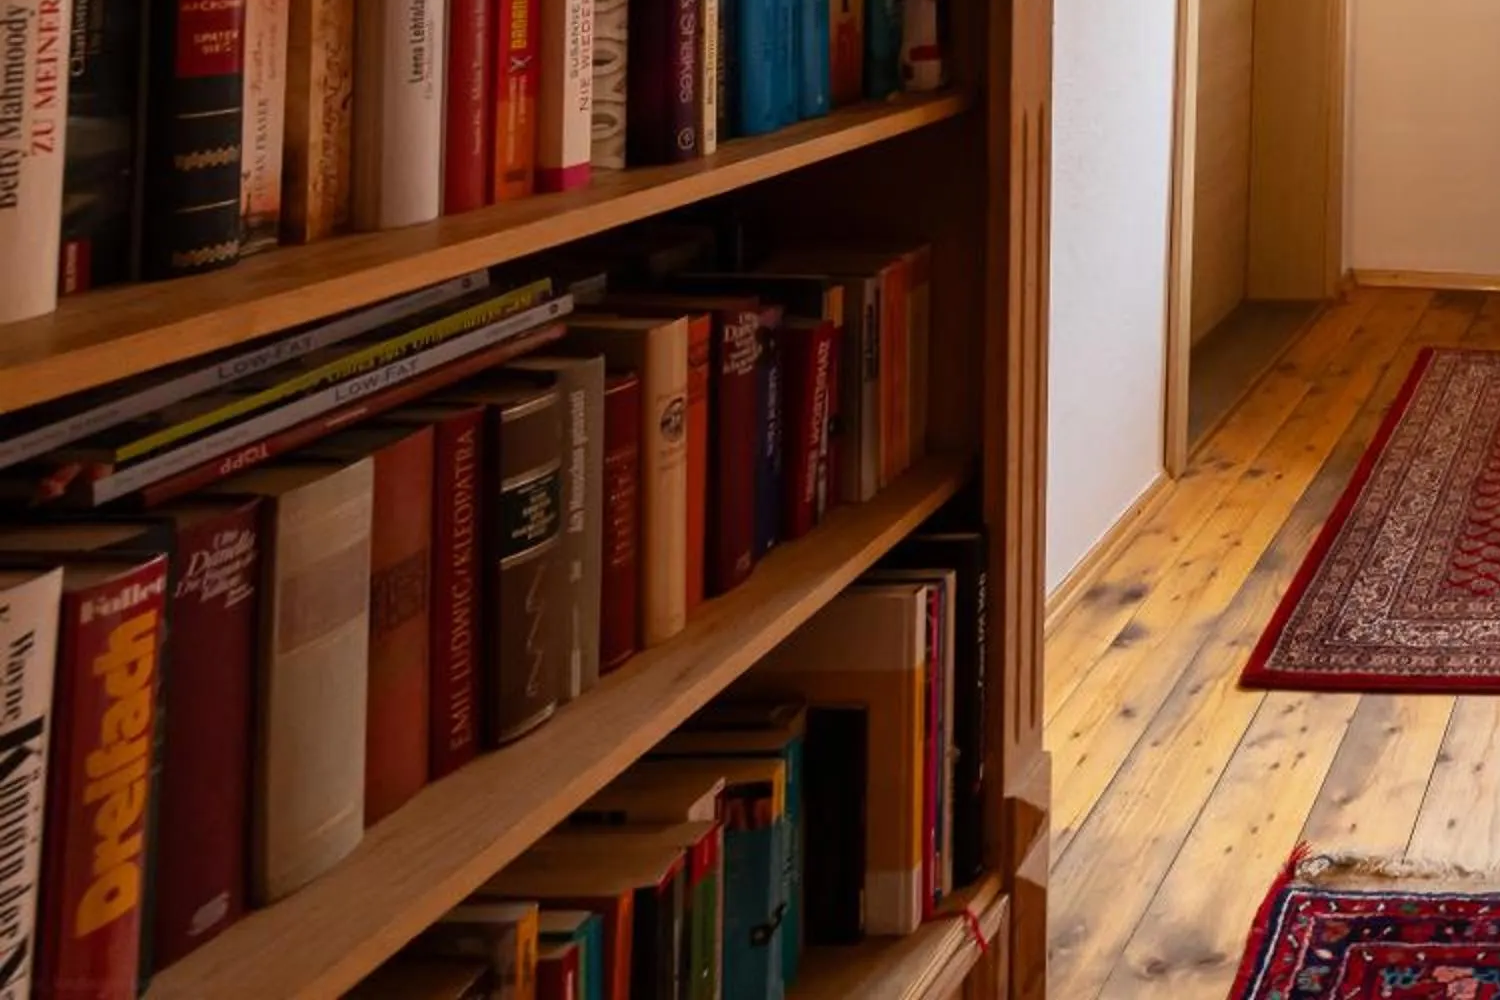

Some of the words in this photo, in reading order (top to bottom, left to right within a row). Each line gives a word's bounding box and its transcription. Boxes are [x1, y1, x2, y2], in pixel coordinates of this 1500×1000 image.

[34, 0, 61, 110] MEINER
[679, 13, 696, 104] Shakes
[31, 120, 53, 157] ZU
[452, 427, 475, 567] KLEOPATRA
[450, 577, 473, 682] LUDWIG
[1, 630, 35, 722] Wayne
[449, 683, 472, 752] EMIL
